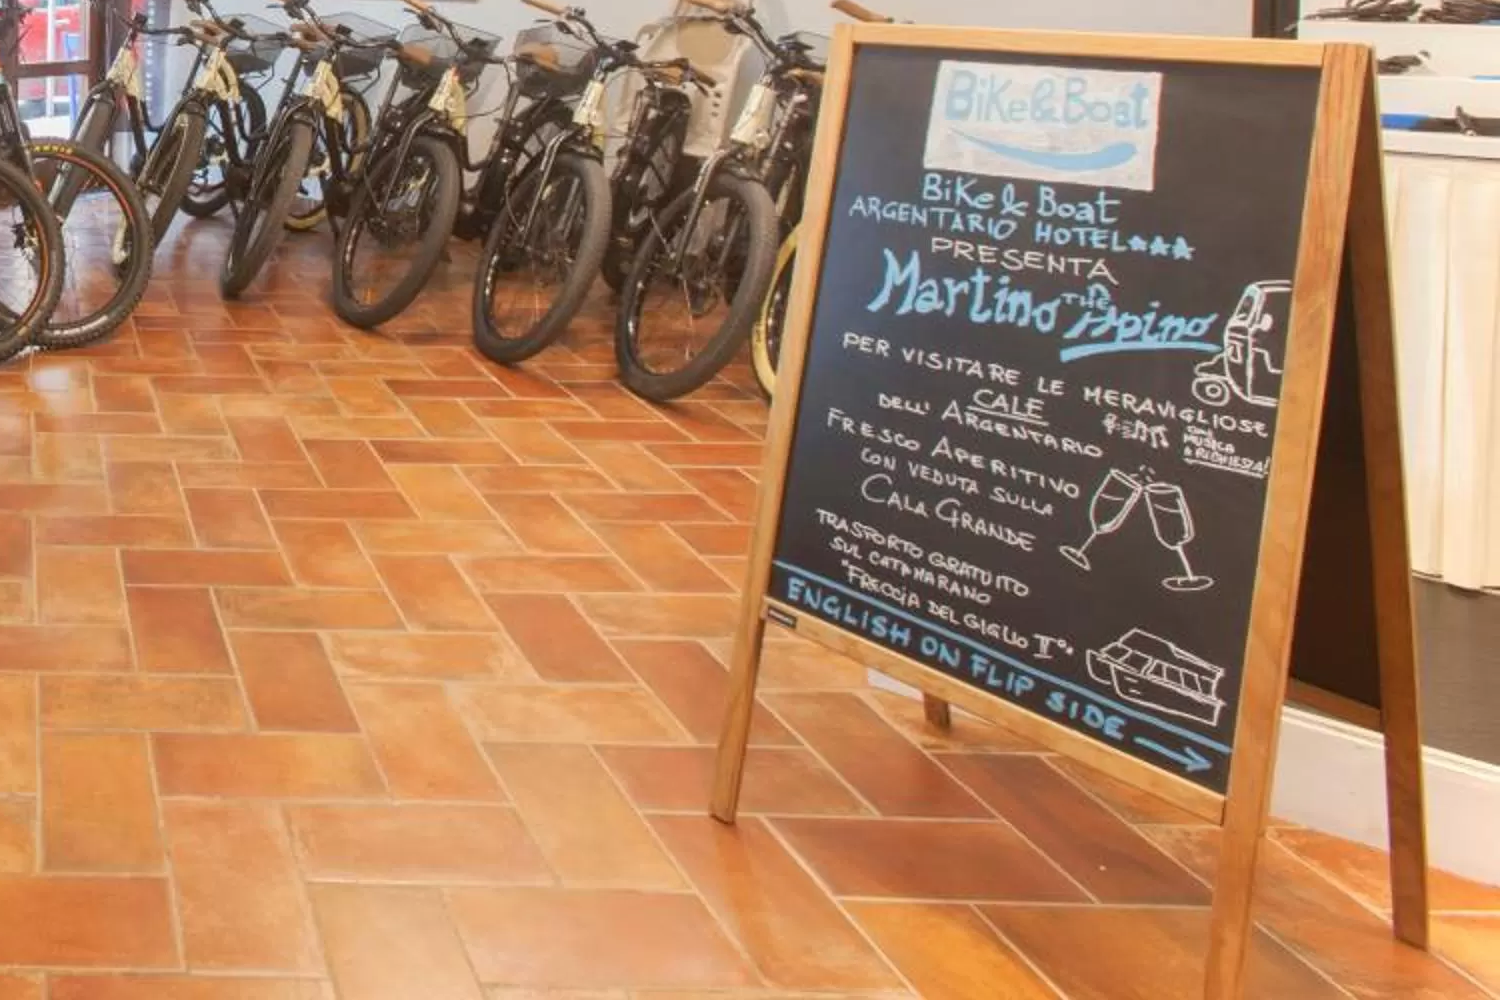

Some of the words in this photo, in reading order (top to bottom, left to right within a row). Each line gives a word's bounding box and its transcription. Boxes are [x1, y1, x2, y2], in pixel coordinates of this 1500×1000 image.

[849, 195, 1018, 240] ARGENTARIO
[1037, 184, 1121, 224] Boat
[867, 248, 1062, 334] Martino
[931, 237, 1119, 286] PRESENTA
[843, 332, 891, 357] PER
[902, 348, 1021, 386] VISITARE
[1037, 376, 1065, 396] LE
[1083, 386, 1269, 438] MERAVIGLIOSE
[972, 388, 1046, 420] CALE
[827, 407, 921, 451] FRESCO
[931, 436, 1080, 499] APERITIVO
[941, 400, 1103, 457] ARGENTARIO
[861, 447, 896, 471] CON
[908, 460, 979, 494] VEDUTA
[989, 487, 1054, 516] SULLA
[861, 473, 929, 518] CALA
[935, 497, 1036, 552] GRANDE
[829, 536, 863, 560] SUL
[868, 551, 991, 604] CATAMARANO
[928, 551, 1030, 597] GRATUITO
[928, 600, 961, 625] DEL
[963, 613, 1029, 649] GIGLIO
[787, 577, 912, 647] ENGLISH
[920, 636, 961, 669] ON
[971, 653, 1035, 697] FLIP
[1045, 691, 1127, 741] SIDE
